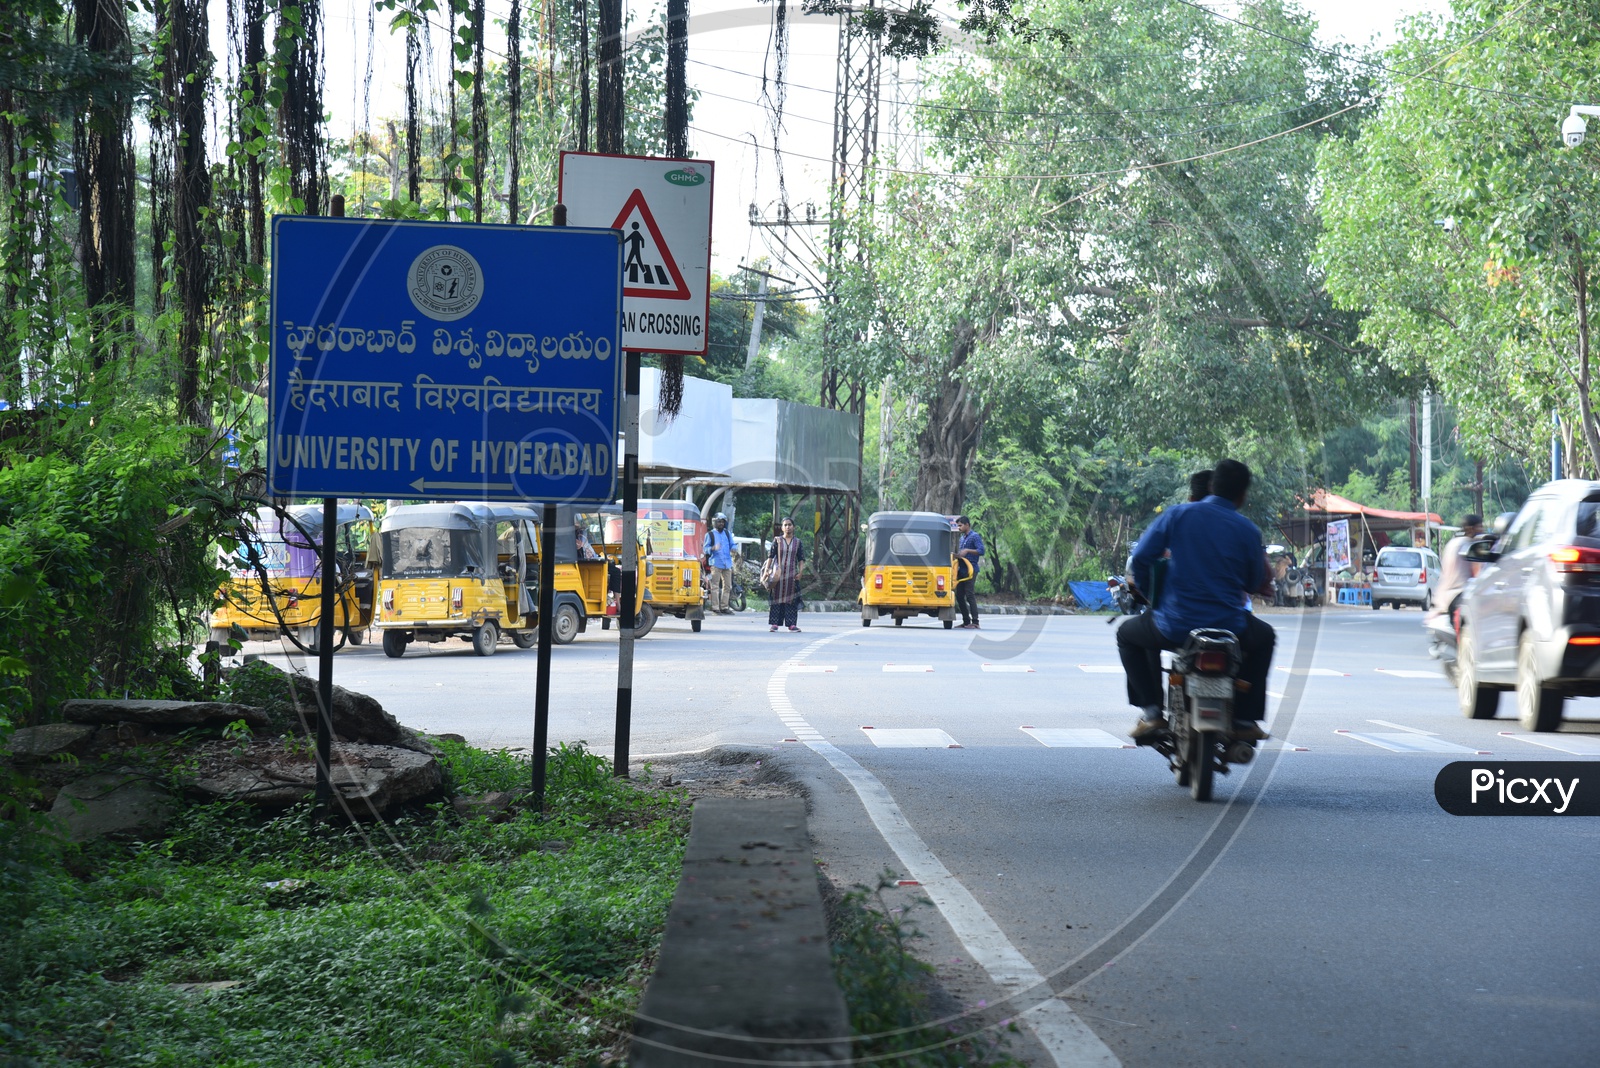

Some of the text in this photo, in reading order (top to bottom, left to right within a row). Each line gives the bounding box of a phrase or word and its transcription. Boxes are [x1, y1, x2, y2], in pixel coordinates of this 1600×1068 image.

[670, 173, 699, 183] GHMC
[418, 250, 441, 288] UNIVERSITY
[453, 251, 474, 292] HYDERABAD
[283, 320, 417, 361] హైదరాబాద్
[622, 311, 701, 336] AN CROSSING
[287, 368, 603, 415] हैदराबाद विश्वविद्यालय
[277, 434, 421, 472] UNIVERSITY
[429, 437, 460, 473] OF
[471, 440, 609, 476] HYDERABAD
